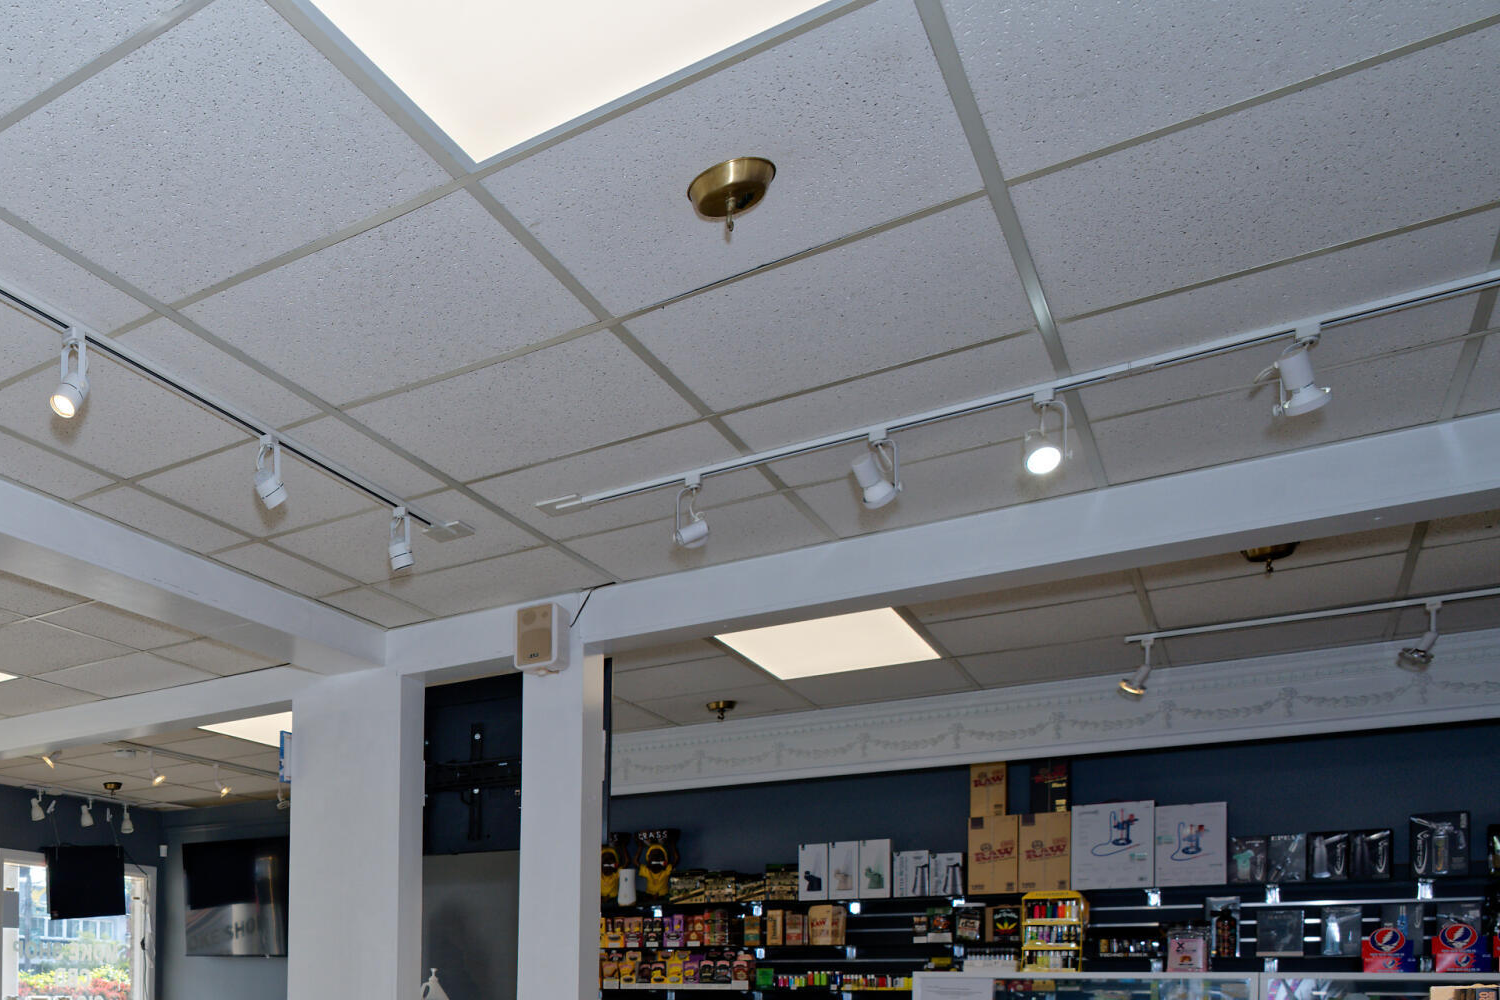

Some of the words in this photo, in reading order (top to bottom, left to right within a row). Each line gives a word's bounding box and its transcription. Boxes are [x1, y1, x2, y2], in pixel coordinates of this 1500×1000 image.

[973, 774, 1004, 788] RAW
[974, 847, 1014, 863] RAW
[1025, 844, 1067, 861] RAW
